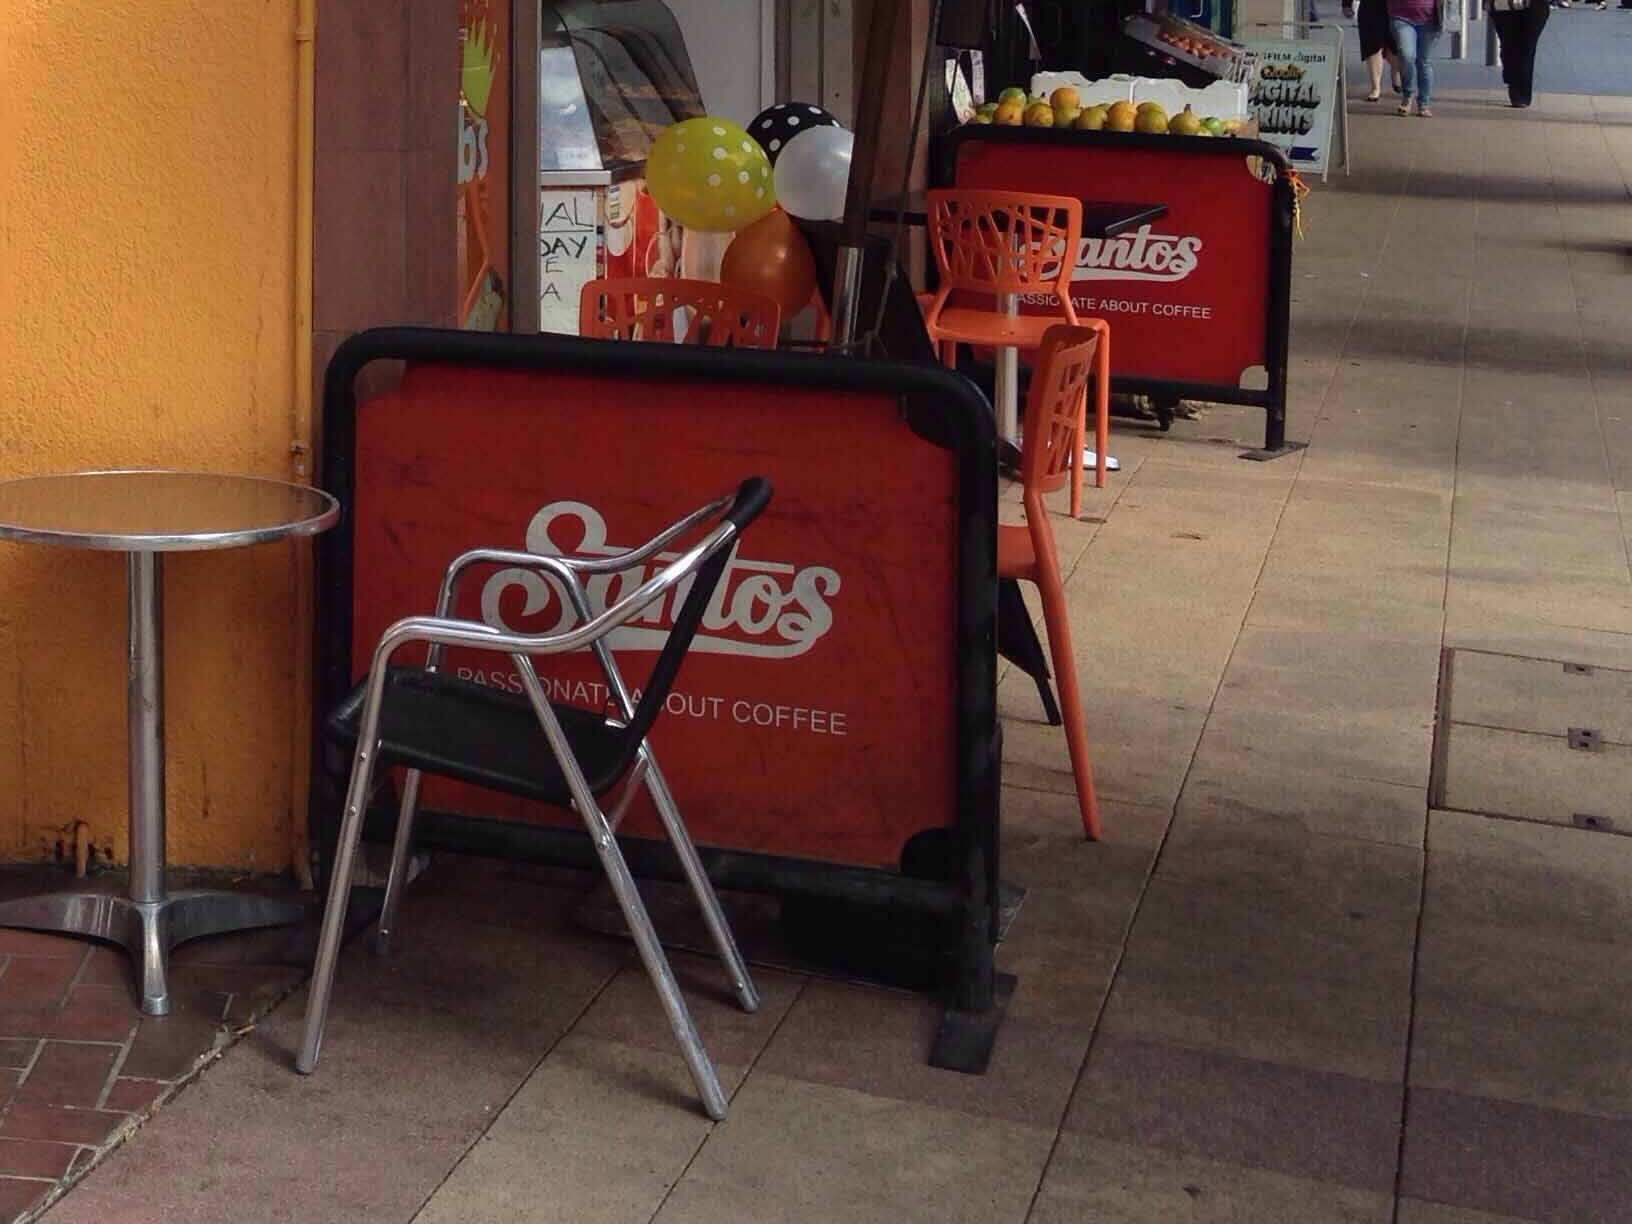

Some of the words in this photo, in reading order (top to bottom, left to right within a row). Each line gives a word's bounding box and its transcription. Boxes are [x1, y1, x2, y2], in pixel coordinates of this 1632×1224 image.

[1098, 298, 1149, 314] ABOUT
[1152, 303, 1213, 320] COFFEE
[480, 500, 842, 659] Santos
[731, 699, 849, 737] COFFEE
